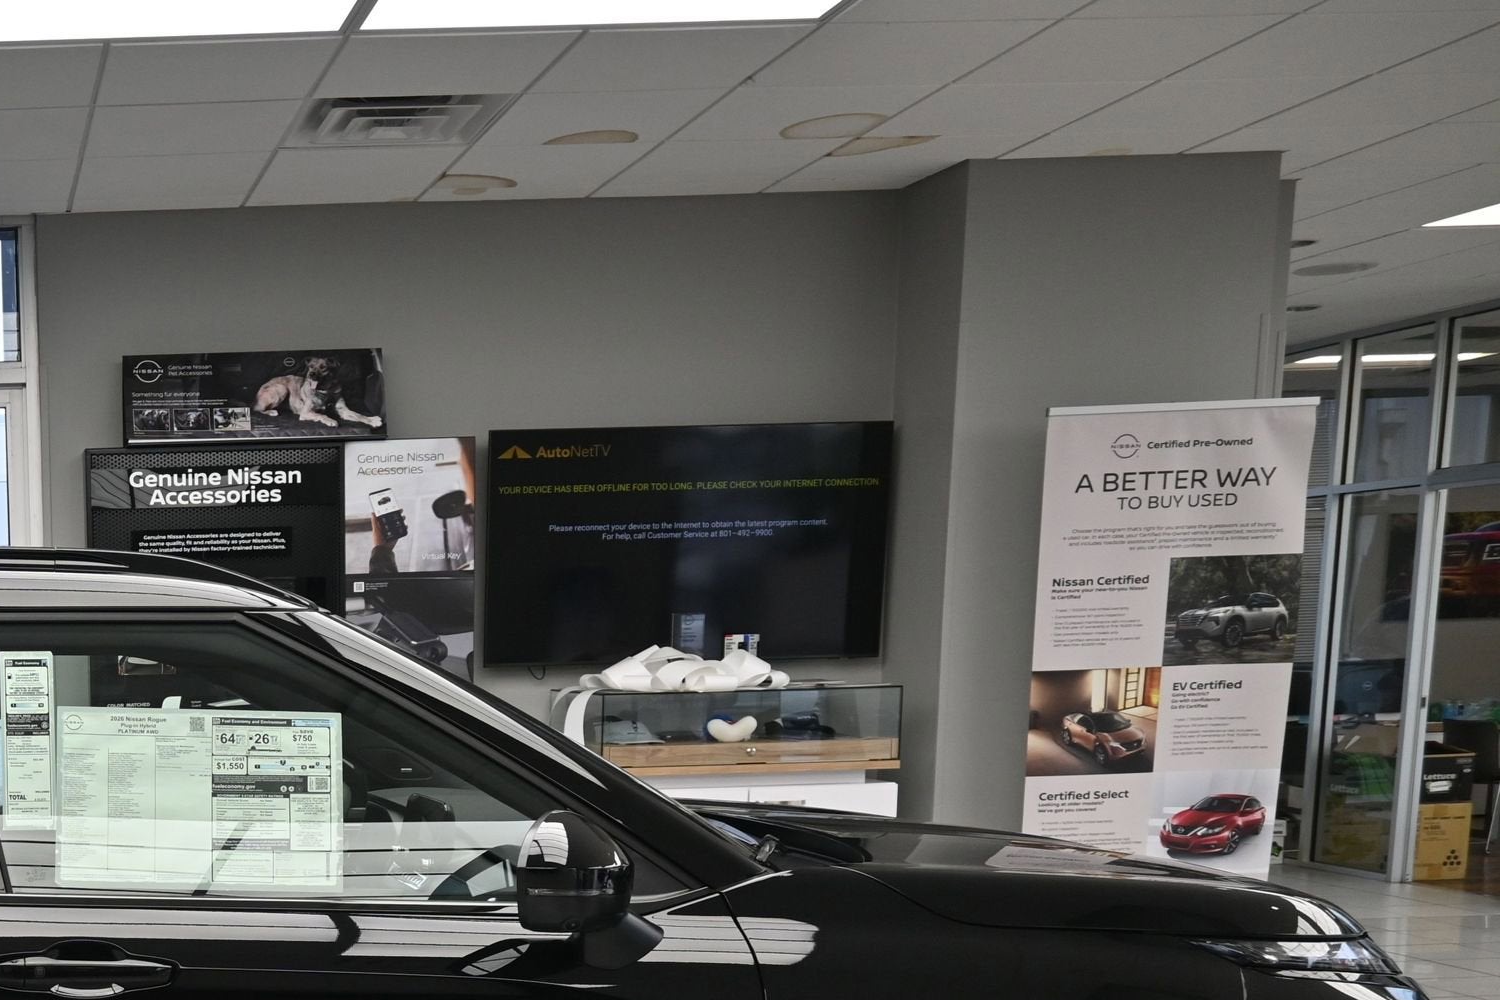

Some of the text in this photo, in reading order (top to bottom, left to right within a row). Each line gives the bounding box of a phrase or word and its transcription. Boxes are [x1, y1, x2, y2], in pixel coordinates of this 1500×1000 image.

[168, 364, 192, 372] Genuine
[131, 391, 164, 399] Something
[1147, 439, 1190, 450] Certified
[1192, 437, 1253, 448] Pre-Owned
[357, 451, 445, 464] Genuine Nissan
[535, 444, 612, 459] AutoNetTV
[357, 465, 424, 476] Accessories
[129, 467, 302, 488] Genuine Nissan
[1075, 466, 1277, 494] A BETTER WAY
[498, 477, 879, 495] YOUR DEVICE HAS BEEN OFFLINE FOR TOO LONG. PLEASE CHECK YOUR INTERNET CONNECTION
[149, 485, 283, 505] Accessories
[1117, 492, 1238, 511] TO BUY USED
[549, 524, 573, 532] Please
[574, 523, 610, 532] reconnect
[611, 524, 626, 532] your
[629, 521, 651, 530] device
[652, 522, 660, 530] to
[661, 521, 673, 529] the
[674, 520, 701, 529] Internet
[702, 520, 710, 528] to
[711, 520, 734, 528] obtain
[734, 519, 746, 527] the
[747, 519, 767, 527] latest
[768, 519, 799, 528] program
[143, 533, 166, 541] Genuine
[187, 532, 218, 540] Accessories
[229, 531, 255, 539] designed
[602, 532, 614, 540] For
[615, 531, 632, 541] help,
[633, 531, 646, 540] call
[647, 530, 682, 539] Customer
[683, 529, 709, 538] Service
[710, 529, 718, 537] at
[421, 551, 462, 561] Virtual Key
[1051, 575, 1150, 587] Nissan Certified
[1172, 679, 1243, 691] EV Certified
[149, 716, 167, 724] Rogue
[220, 733, 236, 744] 64
[254, 733, 270, 745] 26
[292, 734, 313, 742] $750
[216, 762, 245, 770] $1,550
[212, 783, 256, 791] fueleconomy.gov
[1038, 790, 1130, 801] Certified Select
